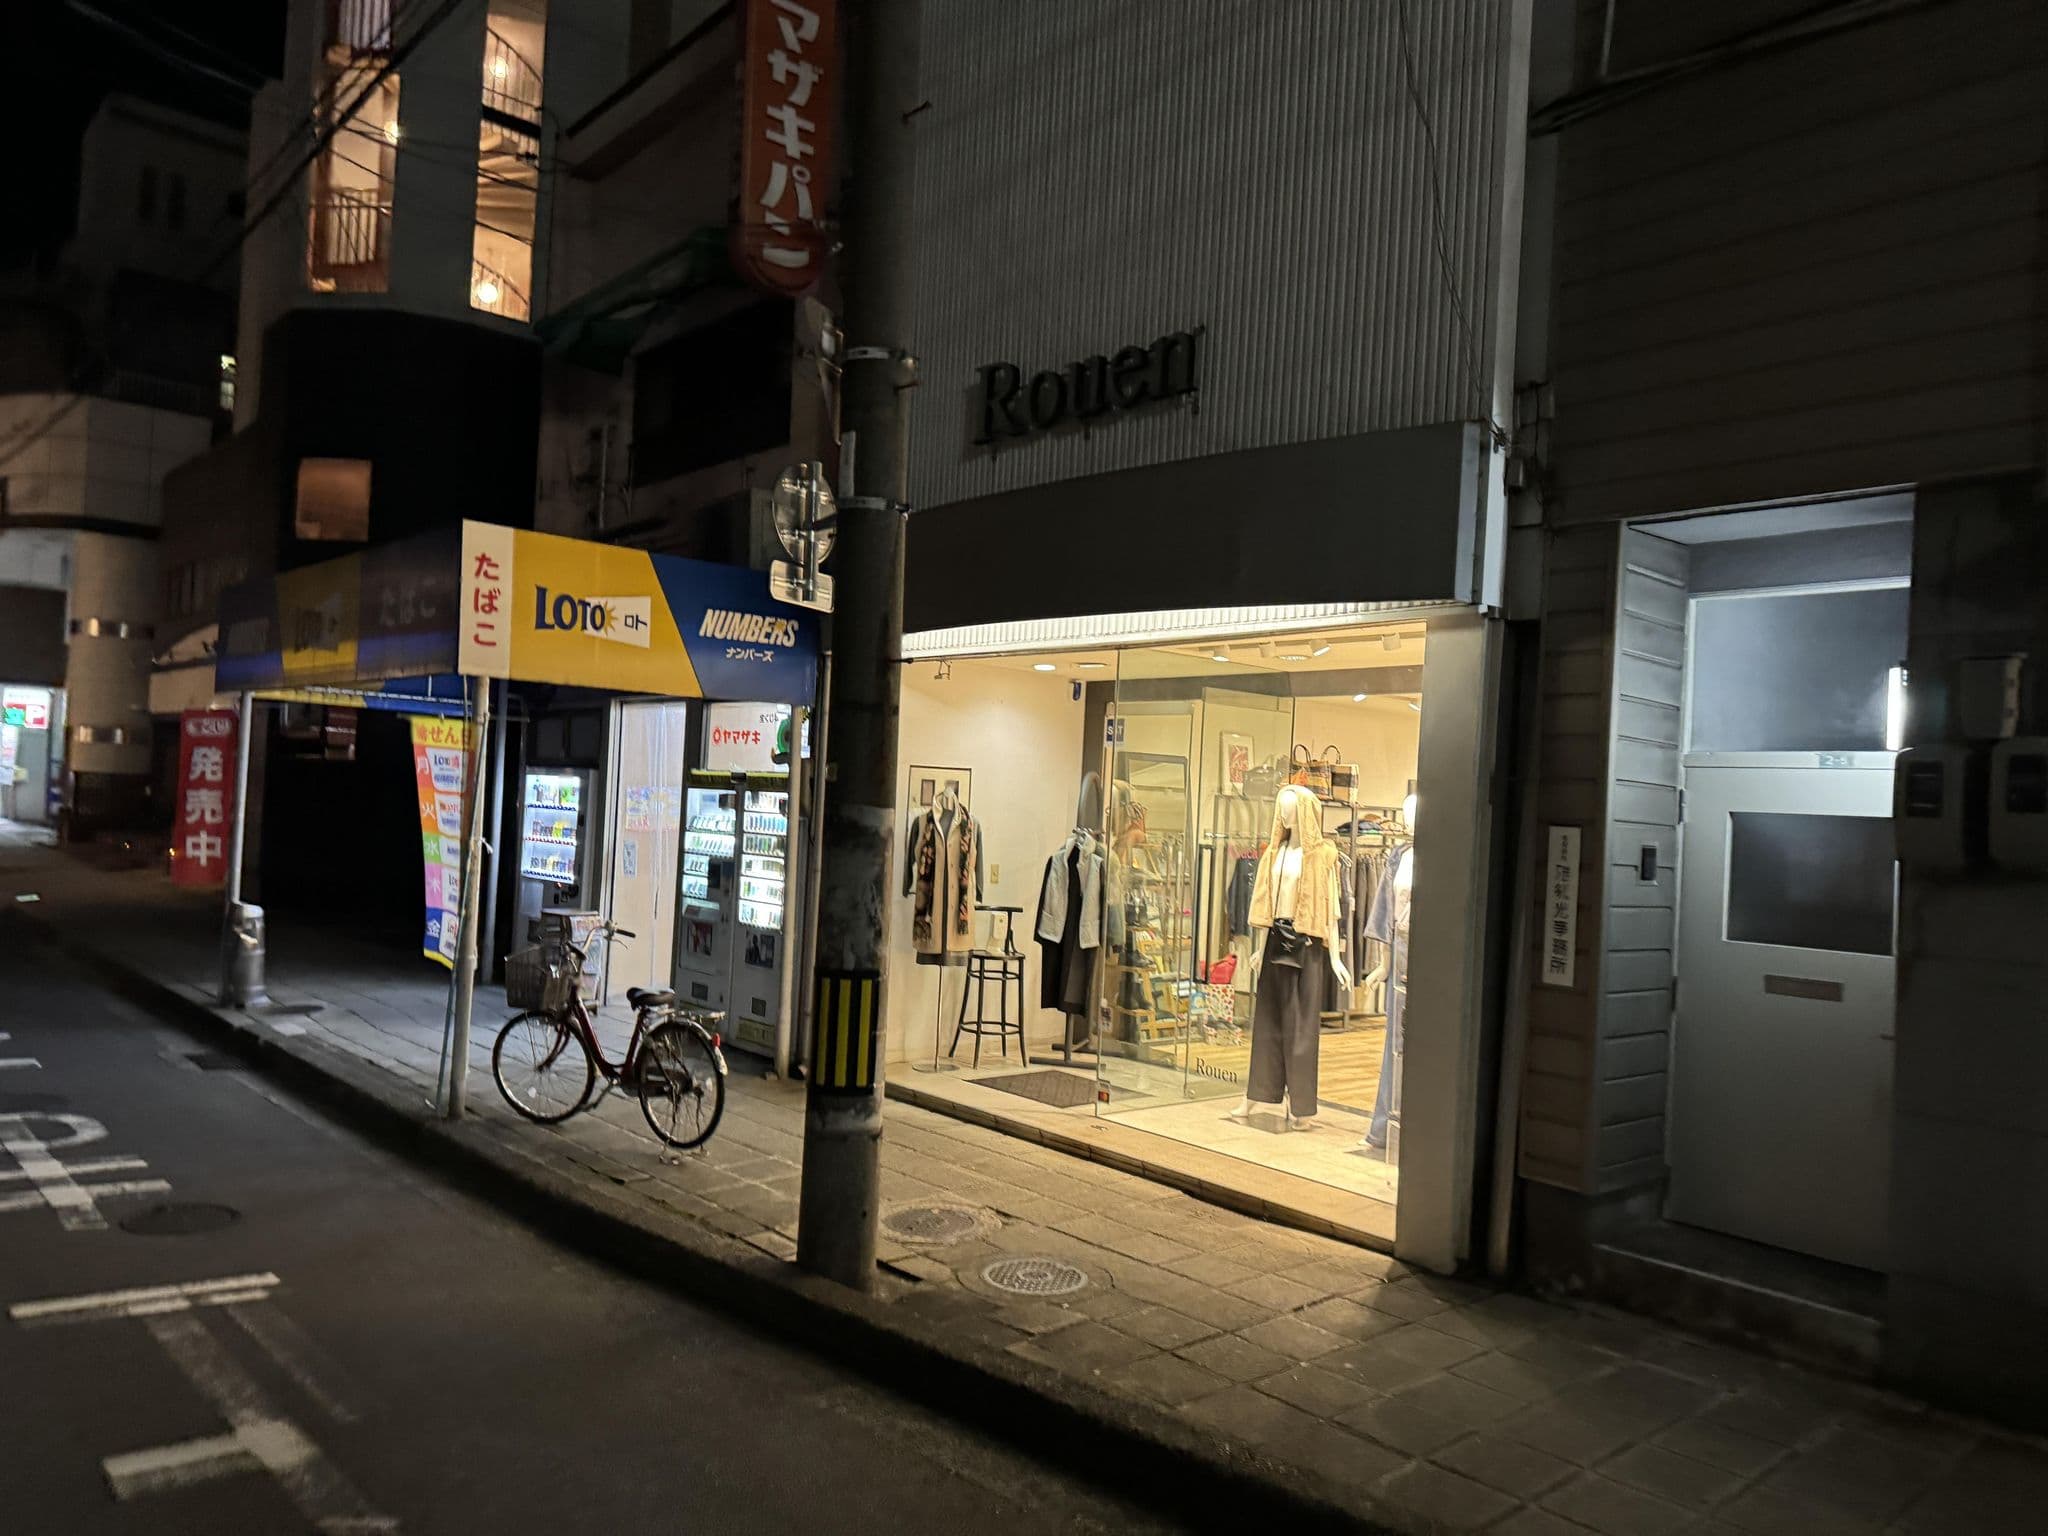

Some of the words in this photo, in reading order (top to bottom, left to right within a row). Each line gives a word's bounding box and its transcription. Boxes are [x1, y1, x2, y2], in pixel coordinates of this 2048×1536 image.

[971, 330, 1199, 446] Rouen
[473, 552, 500, 648] たばこ
[535, 583, 606, 631] LOTO
[699, 608, 798, 648] NUMBERS
[725, 646, 774, 663] ナンバーズ
[185, 746, 224, 868] 発売中
[421, 801, 436, 820] 火
[426, 919, 441, 938] 金
[1196, 1056, 1238, 1084] Rouen
